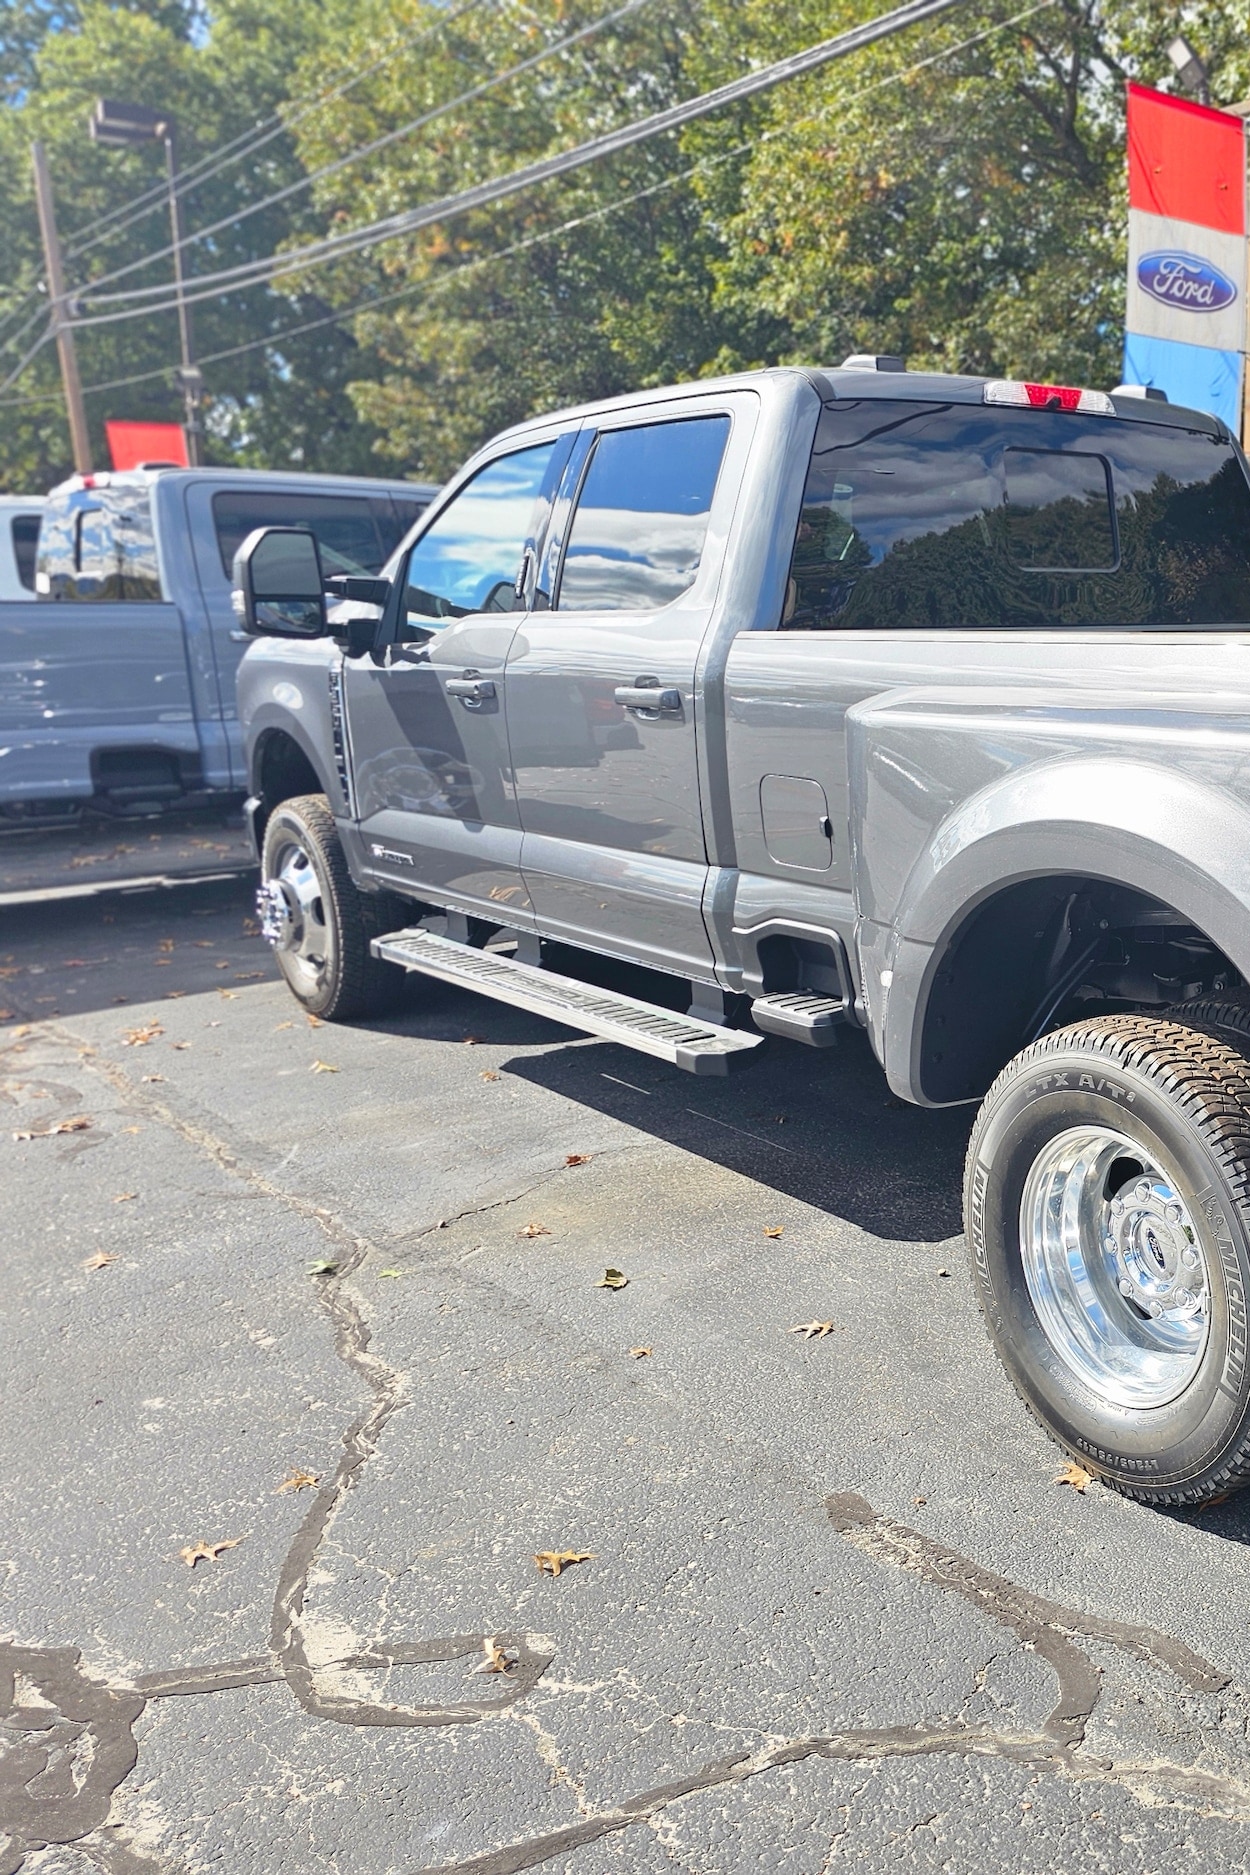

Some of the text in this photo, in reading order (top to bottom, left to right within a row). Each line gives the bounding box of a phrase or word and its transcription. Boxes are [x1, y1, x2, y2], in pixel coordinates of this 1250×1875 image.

[1153, 258, 1216, 305] Ford
[1023, 1073, 1069, 1098] LTX
[972, 1168, 990, 1296] MICHELIN
[1217, 1239, 1247, 1395] MICHELIN
